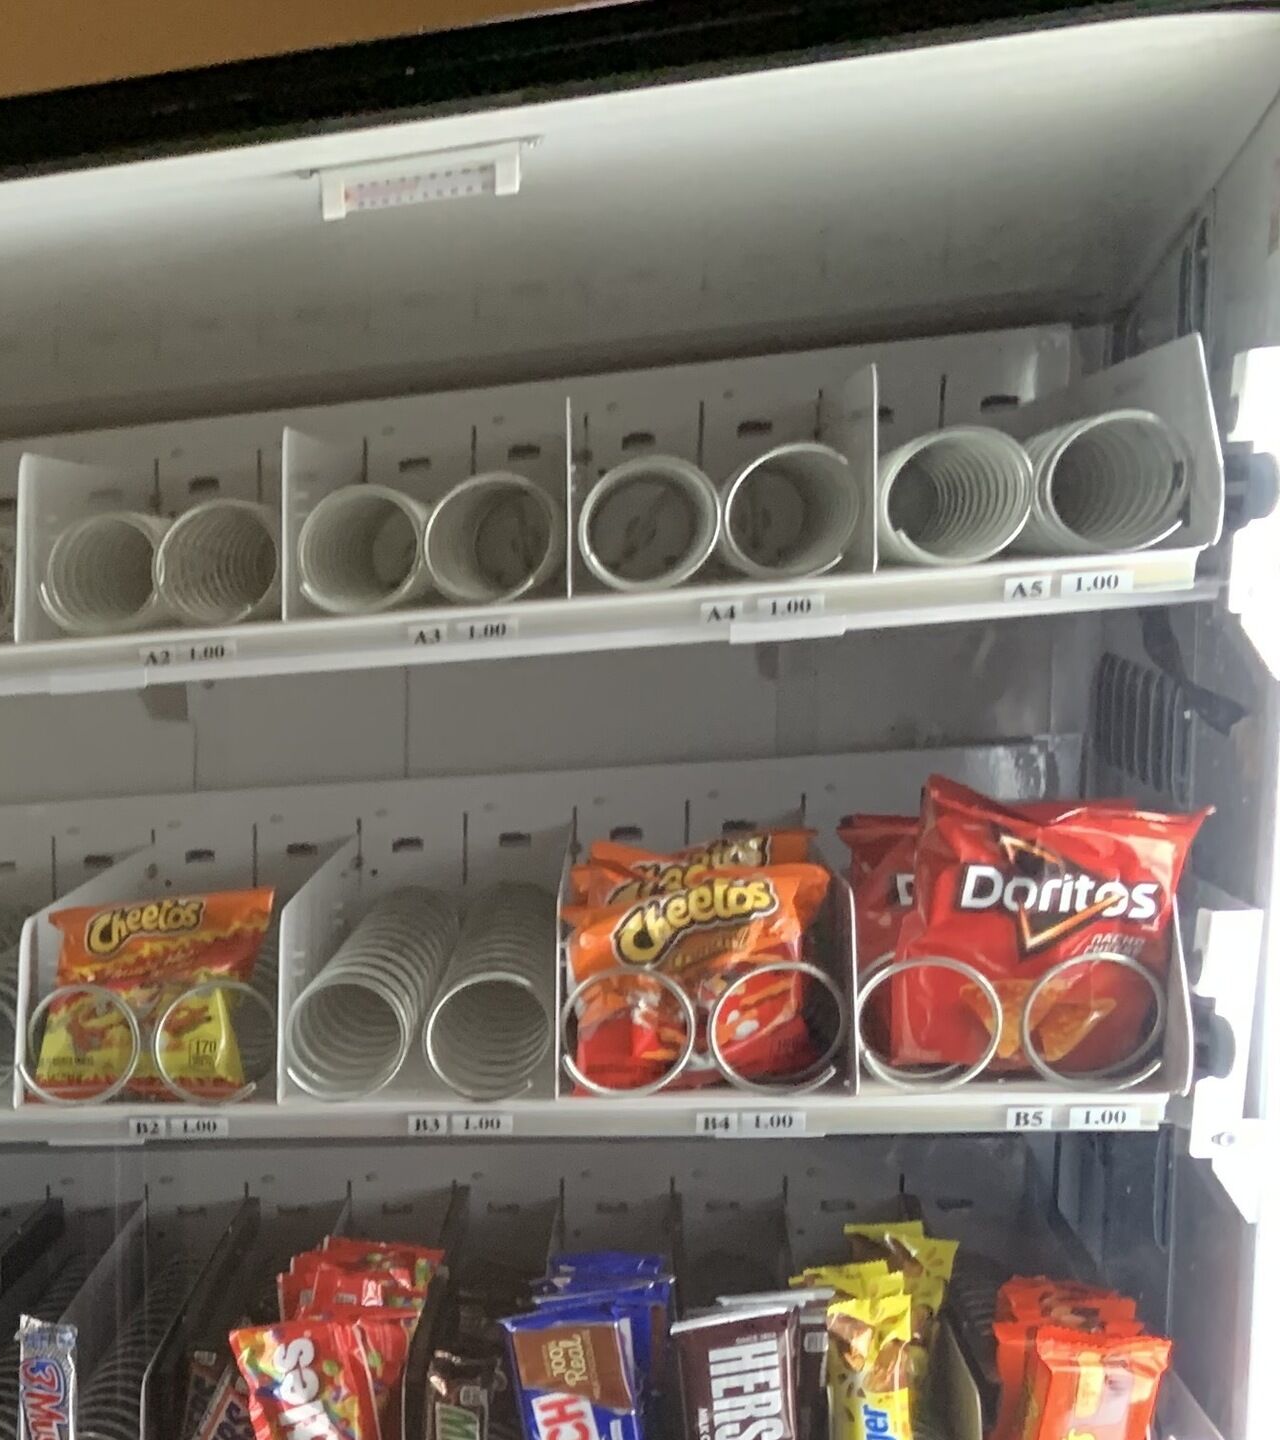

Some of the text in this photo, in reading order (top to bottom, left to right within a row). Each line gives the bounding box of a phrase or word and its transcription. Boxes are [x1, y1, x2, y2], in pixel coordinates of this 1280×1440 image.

[1010, 573, 1120, 599] A5 1.00
[706, 597, 812, 623] A4 1.00
[467, 622, 507, 640] 1.00
[145, 644, 226, 666] A2 1.00
[960, 864, 1161, 921] Doritos
[85, 899, 207, 956] Cheetos
[615, 877, 777, 967] Cheetos
[181, 1118, 218, 1134] 1.00
[463, 1114, 502, 1132] 1.00
[753, 1113, 794, 1130] 1.00
[1012, 1109, 1127, 1128] B5 1.00
